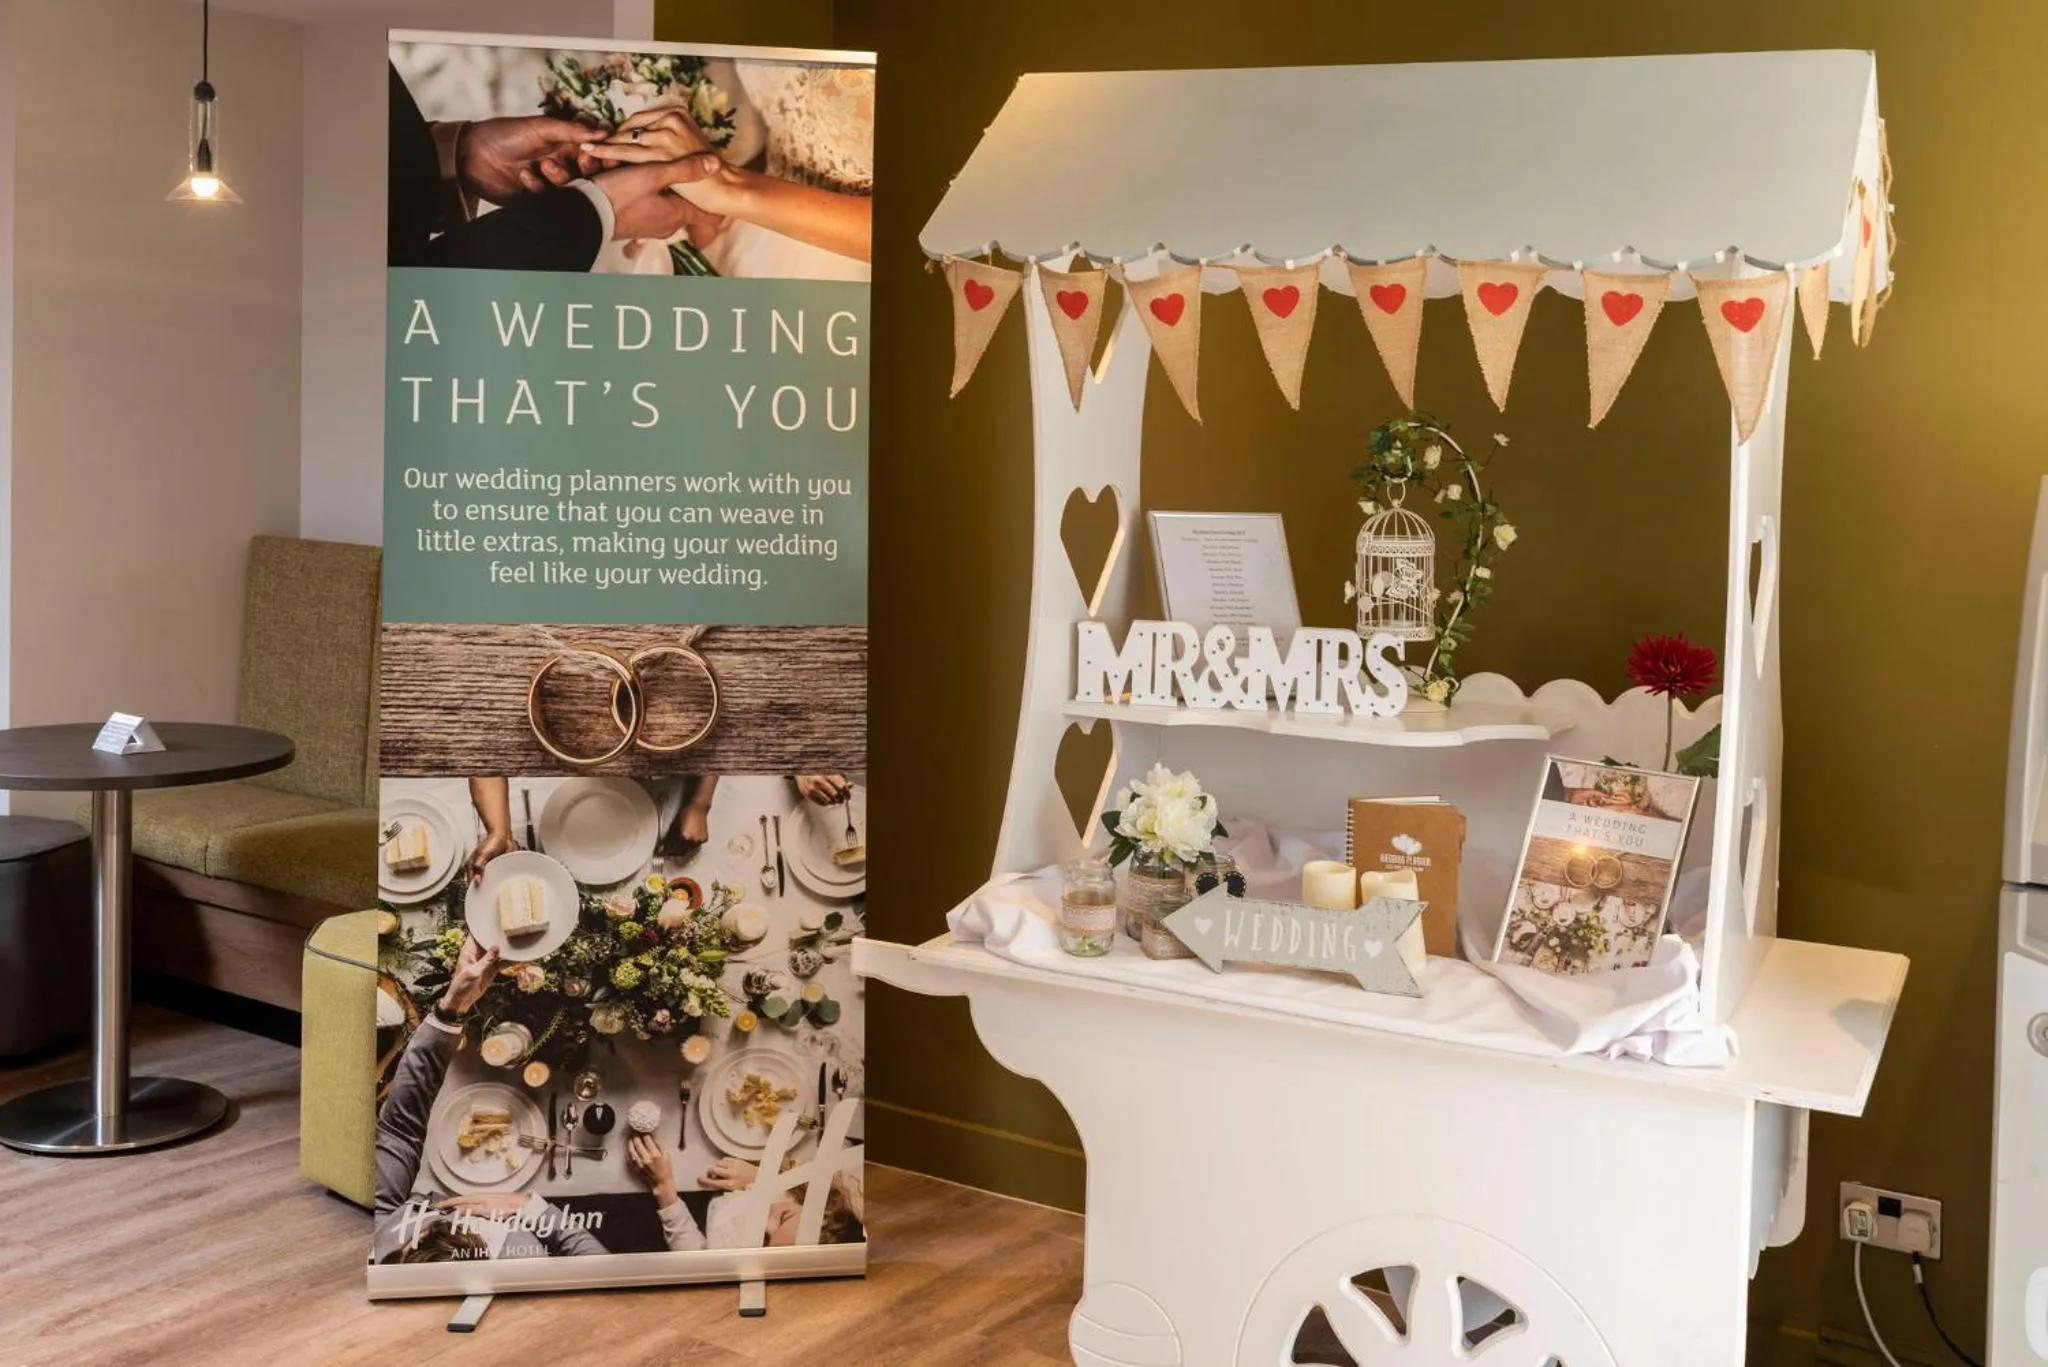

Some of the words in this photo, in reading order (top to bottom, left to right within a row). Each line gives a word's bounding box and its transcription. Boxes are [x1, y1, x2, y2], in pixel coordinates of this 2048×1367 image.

[403, 298, 440, 346] A
[491, 300, 858, 357] WEDDING
[400, 376, 660, 429] THAT'S
[724, 383, 857, 432] YOU
[404, 467, 449, 490] Our
[455, 467, 561, 497] wedding
[569, 468, 677, 497] planners
[682, 471, 741, 494] work
[747, 472, 800, 494] with
[807, 478, 852, 501] you
[432, 499, 459, 520] to
[465, 503, 550, 522] ensure
[556, 499, 609, 523] that
[616, 506, 662, 529] you
[668, 506, 712, 524] can
[719, 507, 795, 525] weave
[801, 503, 824, 525] in
[416, 528, 476, 552] little
[483, 531, 565, 556] extras,
[572, 531, 666, 560] making
[673, 537, 729, 560] your
[735, 533, 838, 562] wedding
[489, 560, 535, 584] feel
[543, 560, 588, 584] like
[595, 567, 652, 590] your
[658, 562, 769, 591] wedding.
[1584, 814, 1647, 834] WEDDING
[1224, 909, 1356, 963] WEDDING
[450, 1204, 555, 1239] Holiday
[558, 1203, 604, 1232] Inn
[451, 1248, 471, 1260] AN
